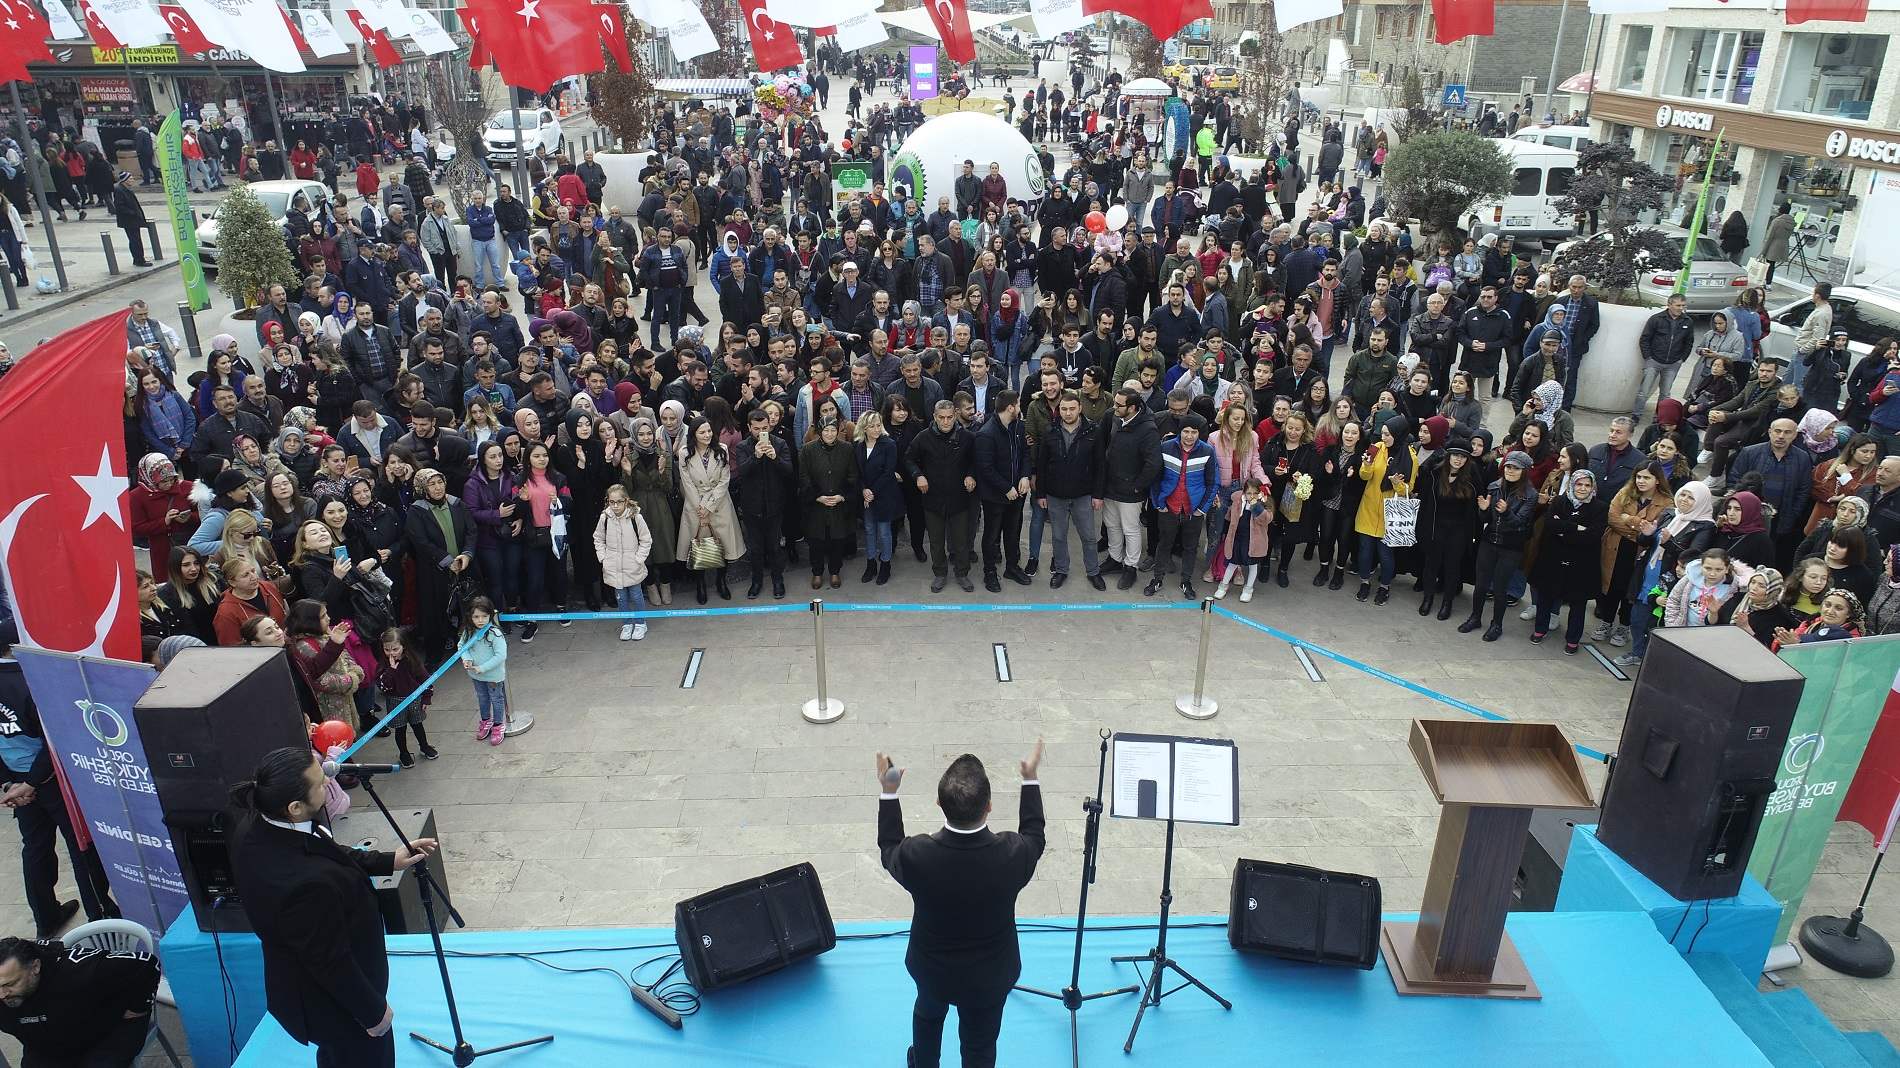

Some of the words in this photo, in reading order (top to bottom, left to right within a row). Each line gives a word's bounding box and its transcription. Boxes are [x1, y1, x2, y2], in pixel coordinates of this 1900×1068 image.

[208, 49, 250, 61] CANS
[83, 85, 131, 94] PİJAMALARD
[1671, 109, 1714, 132] BOSCH
